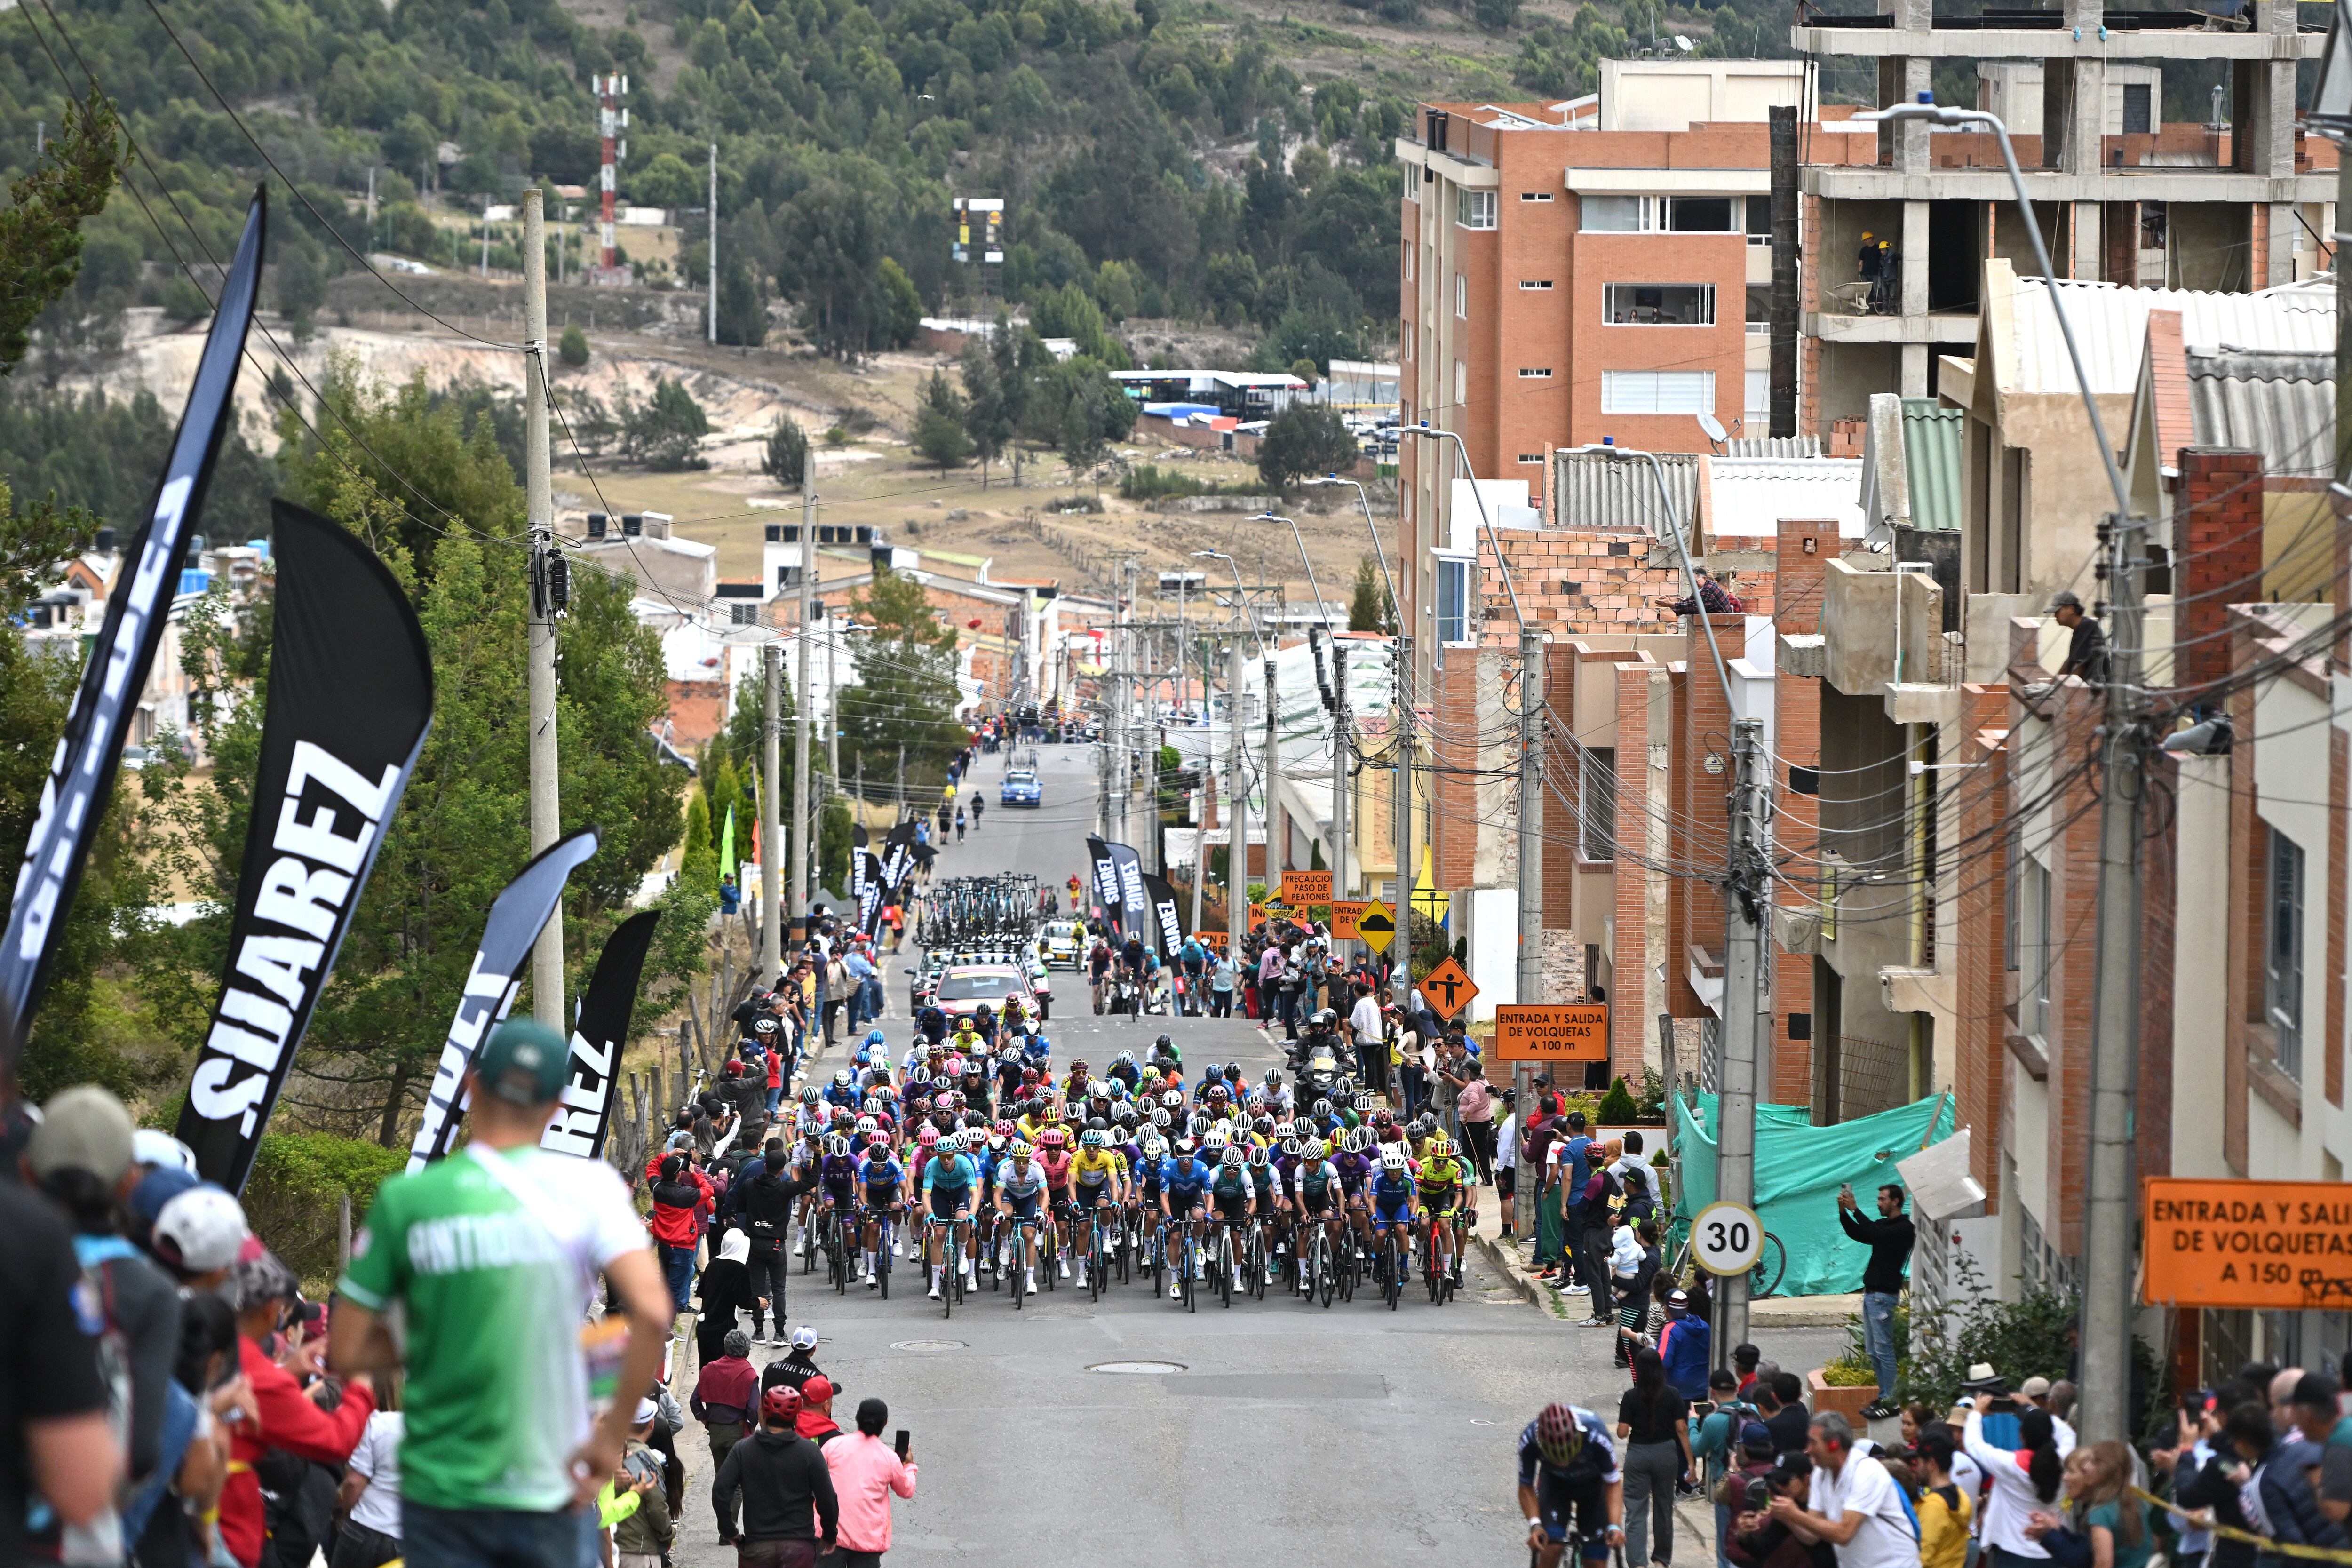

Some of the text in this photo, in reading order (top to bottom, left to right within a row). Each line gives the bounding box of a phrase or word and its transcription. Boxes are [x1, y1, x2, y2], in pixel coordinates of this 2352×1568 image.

[1096, 856, 1120, 905] SUAREZ
[1156, 898, 1182, 957] SUAREZ
[191, 740, 402, 1140] SUAREZ
[1220, 935, 1228, 944] D
[1500, 1013, 1603, 1024] ENTRADA Y SALIDA
[1509, 1027, 1591, 1037] DE VOLQUETAS
[1530, 1041, 1537, 1050] A
[1542, 1041, 1561, 1050] 100
[869, 1174, 896, 1183] Colombia
[2154, 1199, 2352, 1225] ENTRADA Y SALI
[1707, 1222, 1750, 1254] 30
[2173, 1230, 2204, 1252] DE
[2221, 1263, 2238, 1282] A
[2249, 1263, 2291, 1284] 150
[772, 1362, 817, 1377] CULTURE BIKE
